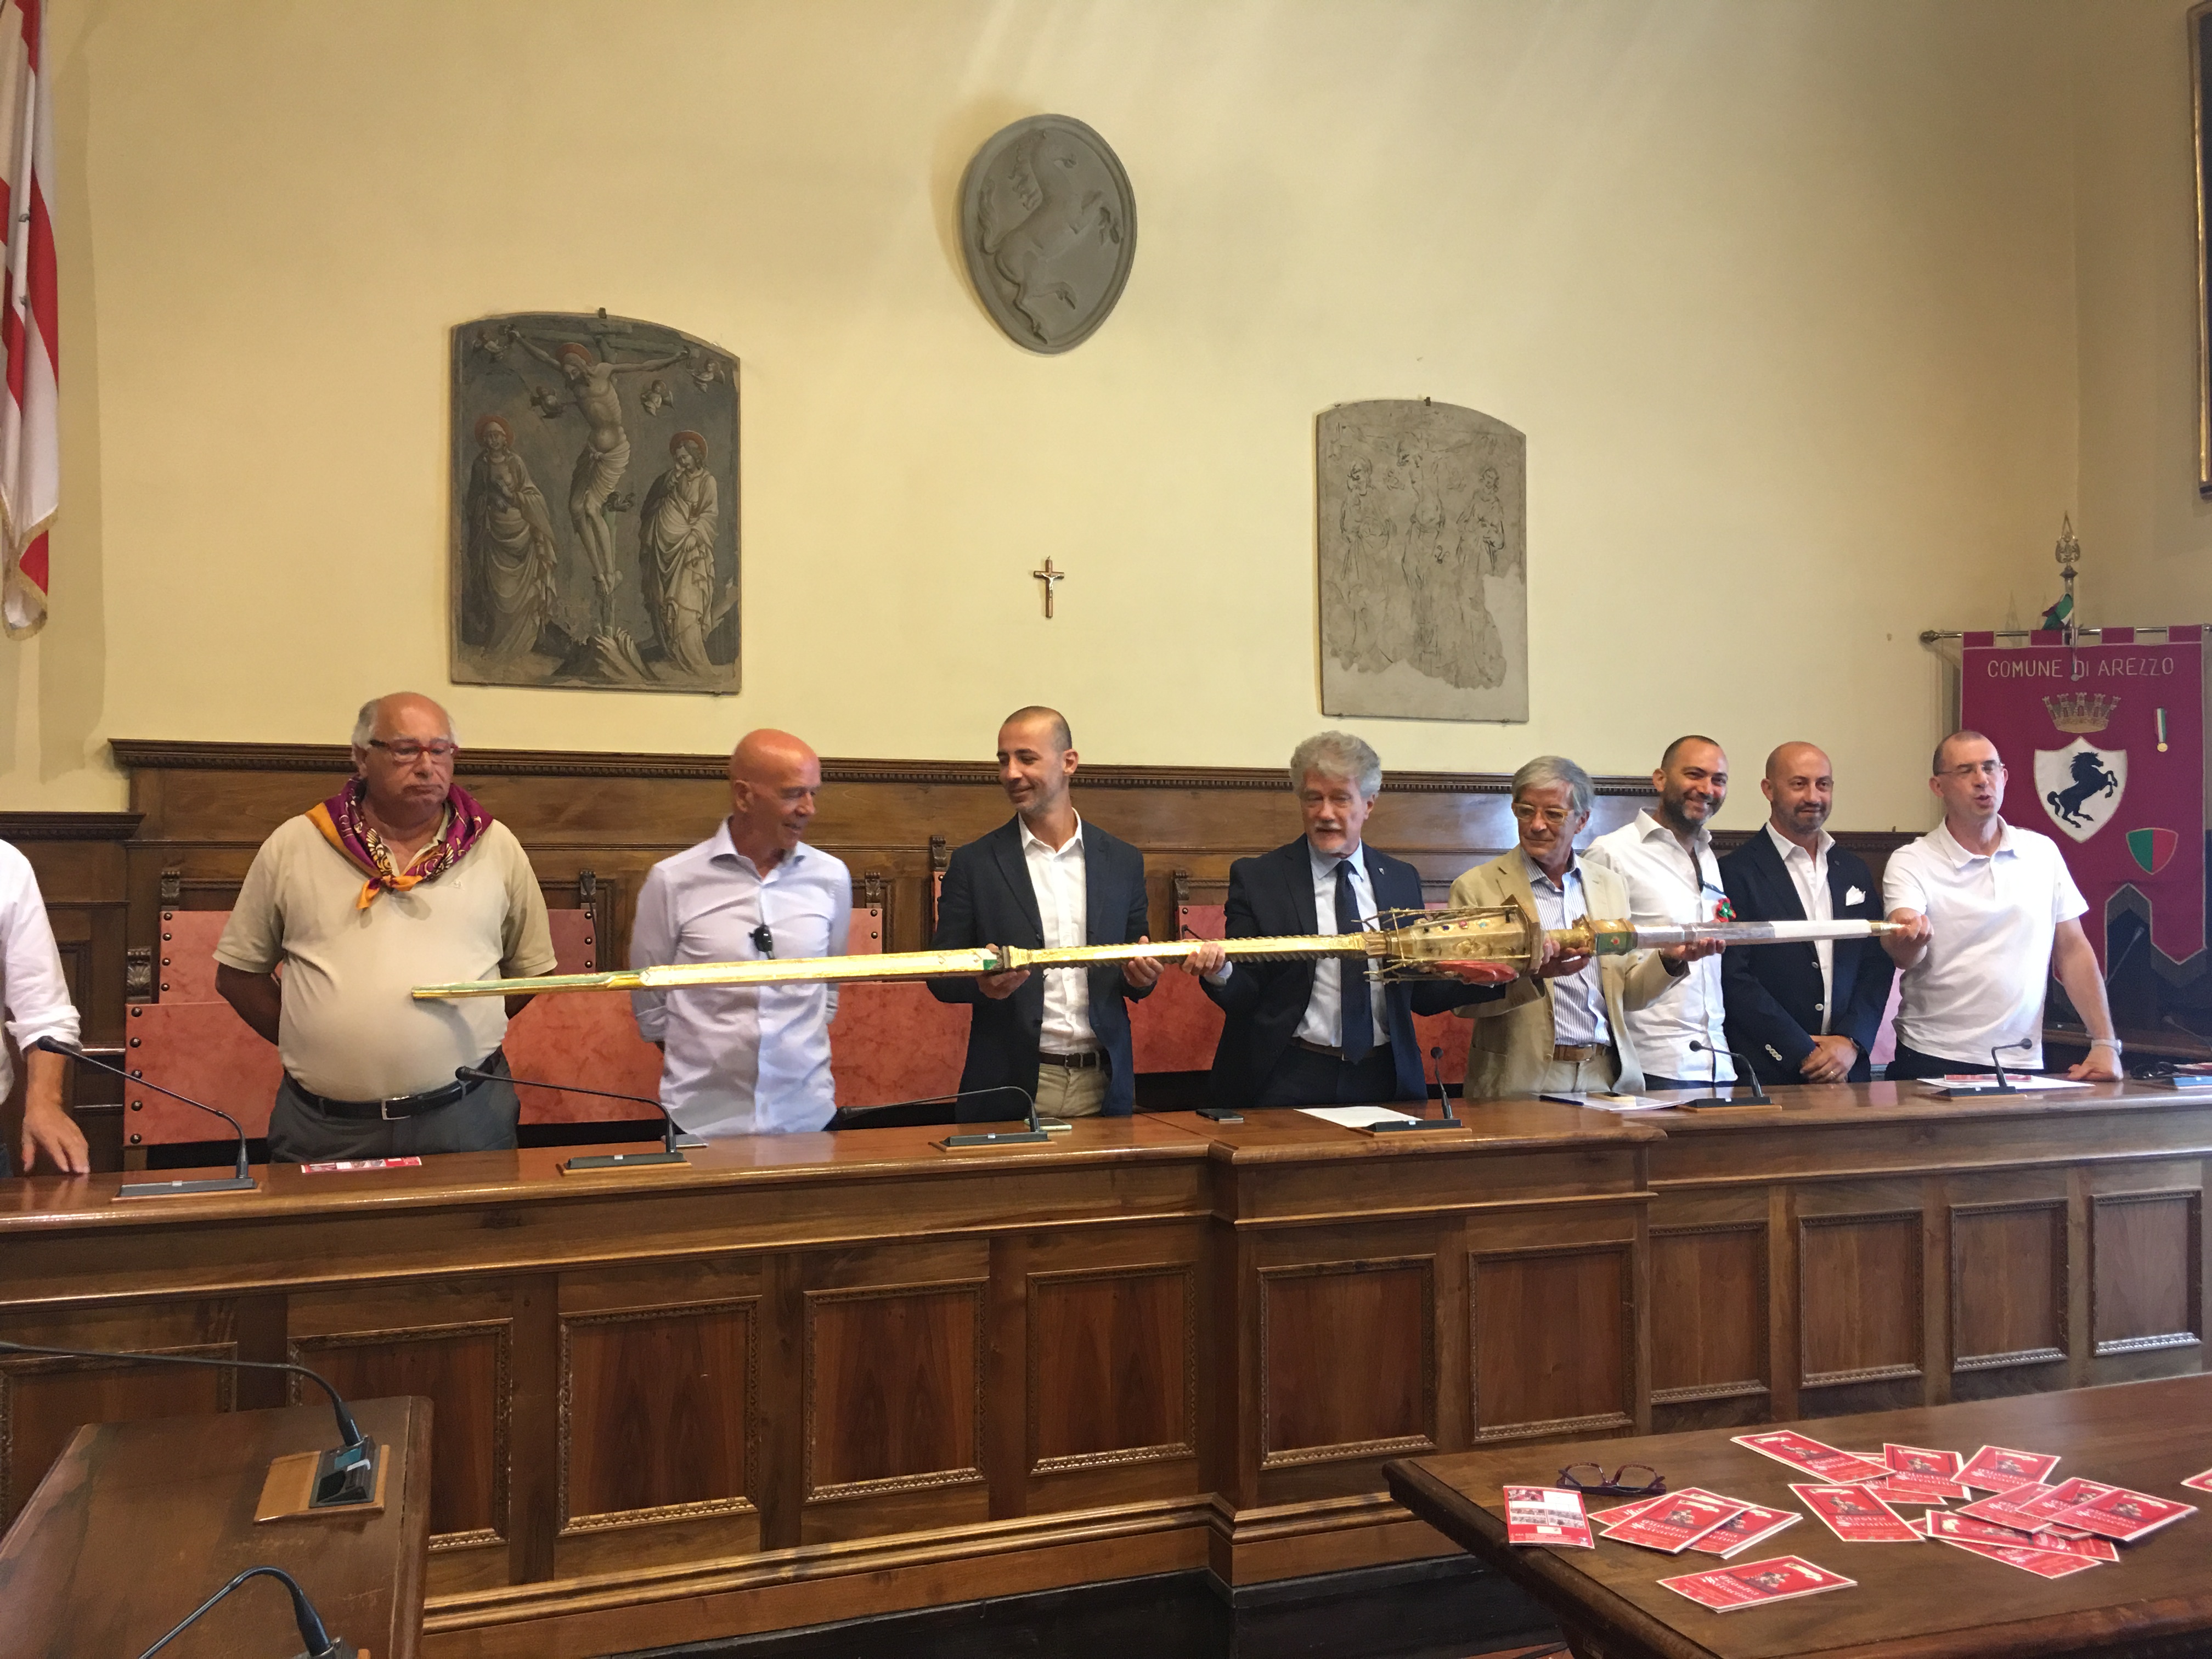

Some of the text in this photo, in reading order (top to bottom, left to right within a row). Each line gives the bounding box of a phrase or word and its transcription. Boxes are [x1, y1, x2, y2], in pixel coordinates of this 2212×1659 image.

[1987, 657, 2174, 678] COMUNE DI AREZZO
